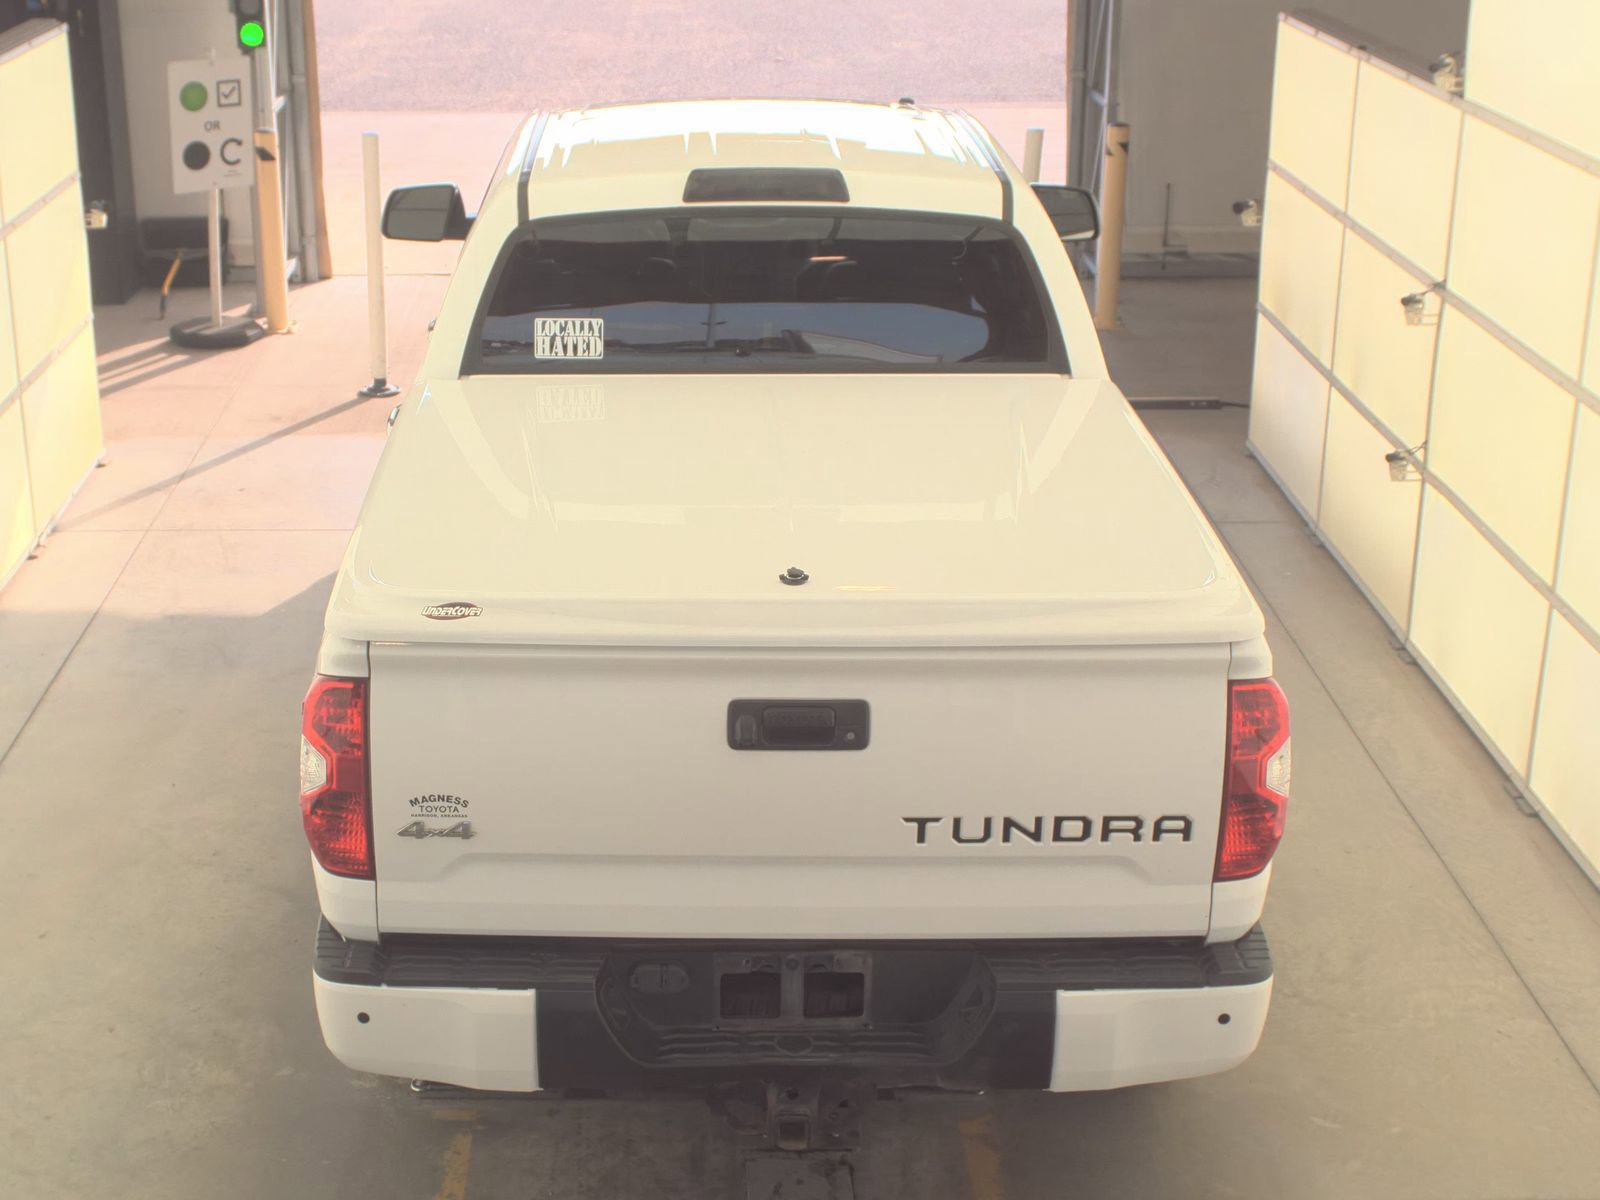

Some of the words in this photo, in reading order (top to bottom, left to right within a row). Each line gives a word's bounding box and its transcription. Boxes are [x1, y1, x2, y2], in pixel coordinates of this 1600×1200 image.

[203, 120, 221, 132] OR
[535, 319, 602, 337] LOCALLY
[535, 336, 602, 357] HATED
[408, 794, 470, 809] MAGNESS
[418, 805, 460, 814] TOYOTA
[900, 815, 1193, 845] TUNDRA
